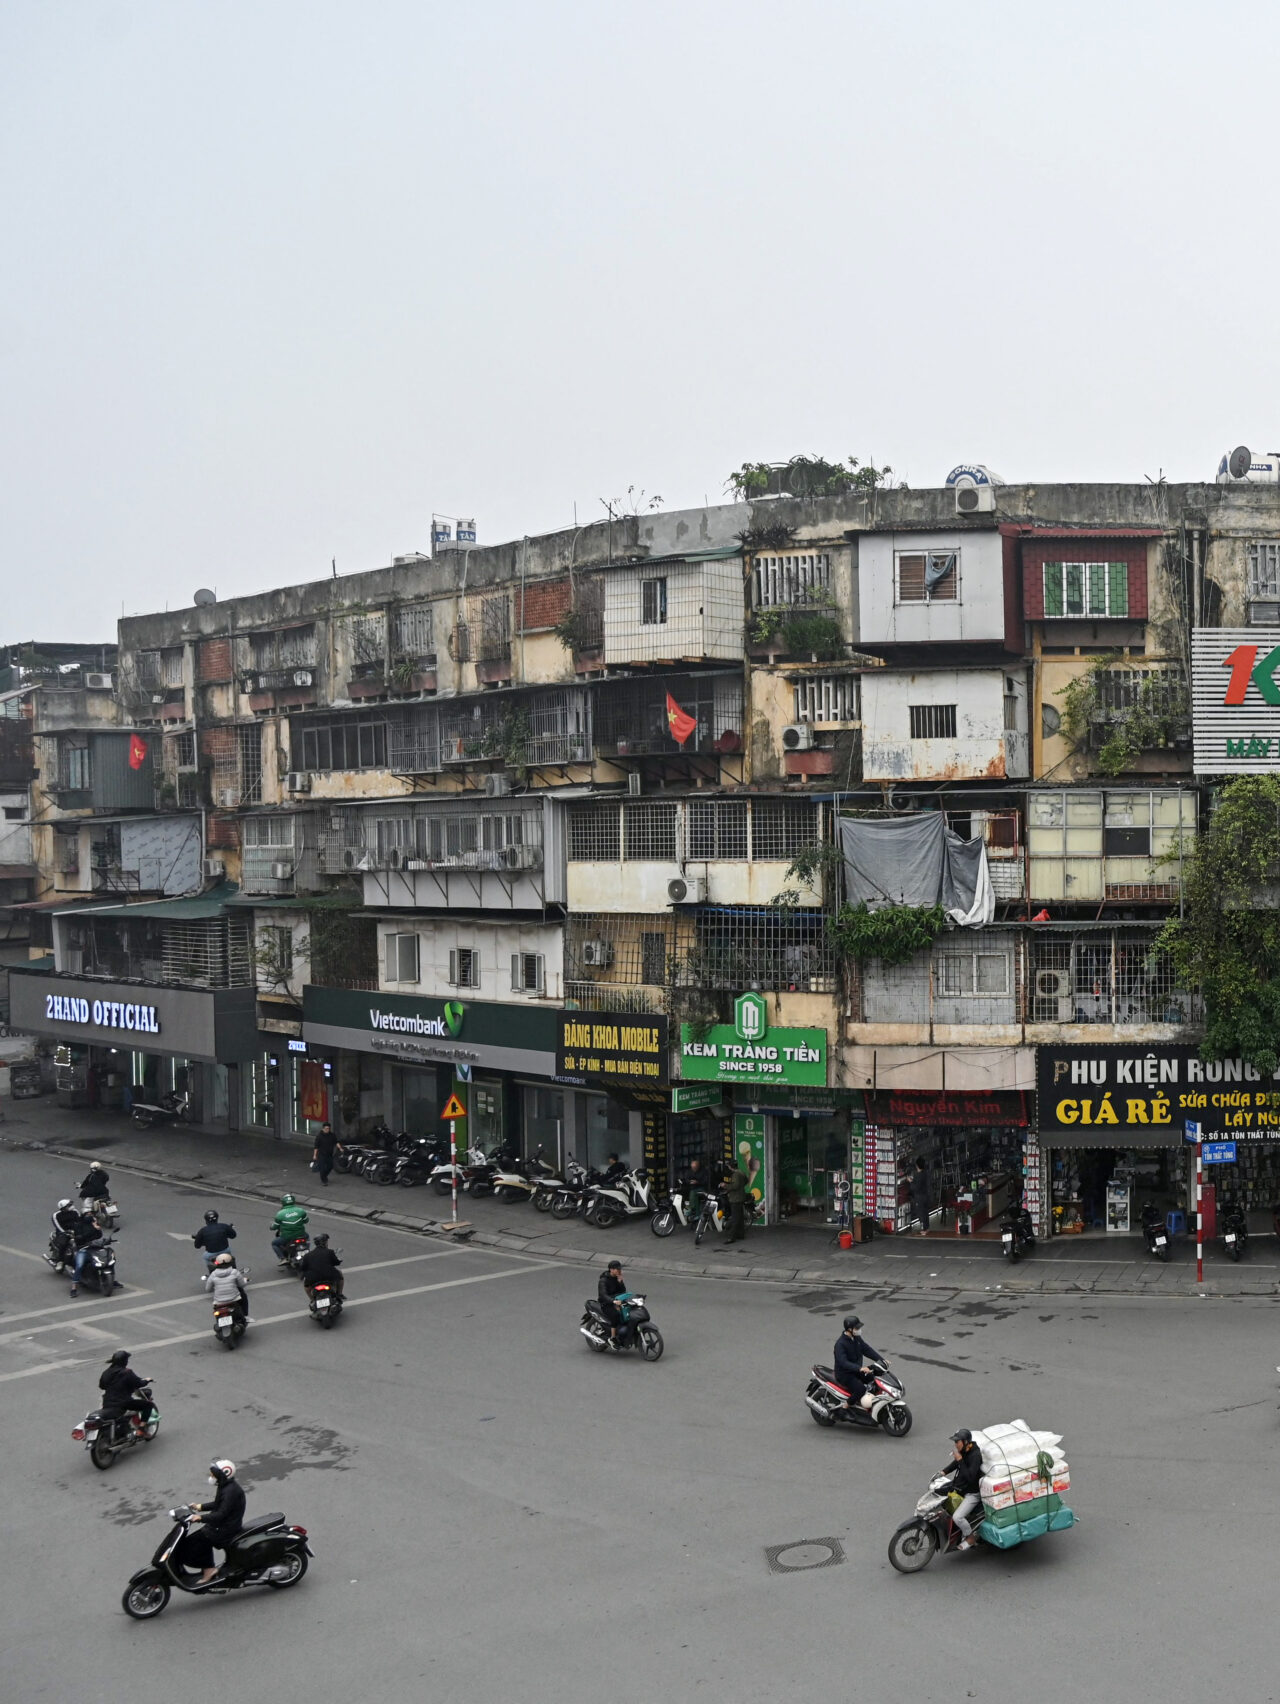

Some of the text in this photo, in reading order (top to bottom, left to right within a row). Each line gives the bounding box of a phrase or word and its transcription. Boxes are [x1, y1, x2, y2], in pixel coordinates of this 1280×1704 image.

[1226, 733, 1272, 758] MÁY
[46, 994, 159, 1033] 2HAND OFFICIAL
[369, 1009, 446, 1036] Vietcombank
[564, 1019, 659, 1053] ĐĂNG KHOA MOBILE
[683, 1040, 820, 1062] KEM TRÀNG TIỀN
[587, 1056, 601, 1072] KÍNH
[604, 1059, 617, 1073] MUA
[617, 1058, 629, 1074] BÁN
[719, 1061, 782, 1073] SINCE 1958
[1053, 1060, 1107, 1088] PHỤ
[1117, 1053, 1179, 1089] KIỆN
[965, 1100, 1001, 1114] Kim
[1055, 1090, 1172, 1125] GIÁ RẺ
[1178, 1090, 1207, 1108] SỬA
[1211, 1090, 1251, 1108] CHỮA
[1224, 1109, 1254, 1127] LẤY
[1208, 1130, 1219, 1140] SỐ
[1220, 1132, 1229, 1140] 1A
[1231, 1130, 1245, 1140] TÔN
[1247, 1128, 1264, 1139] THẤT
